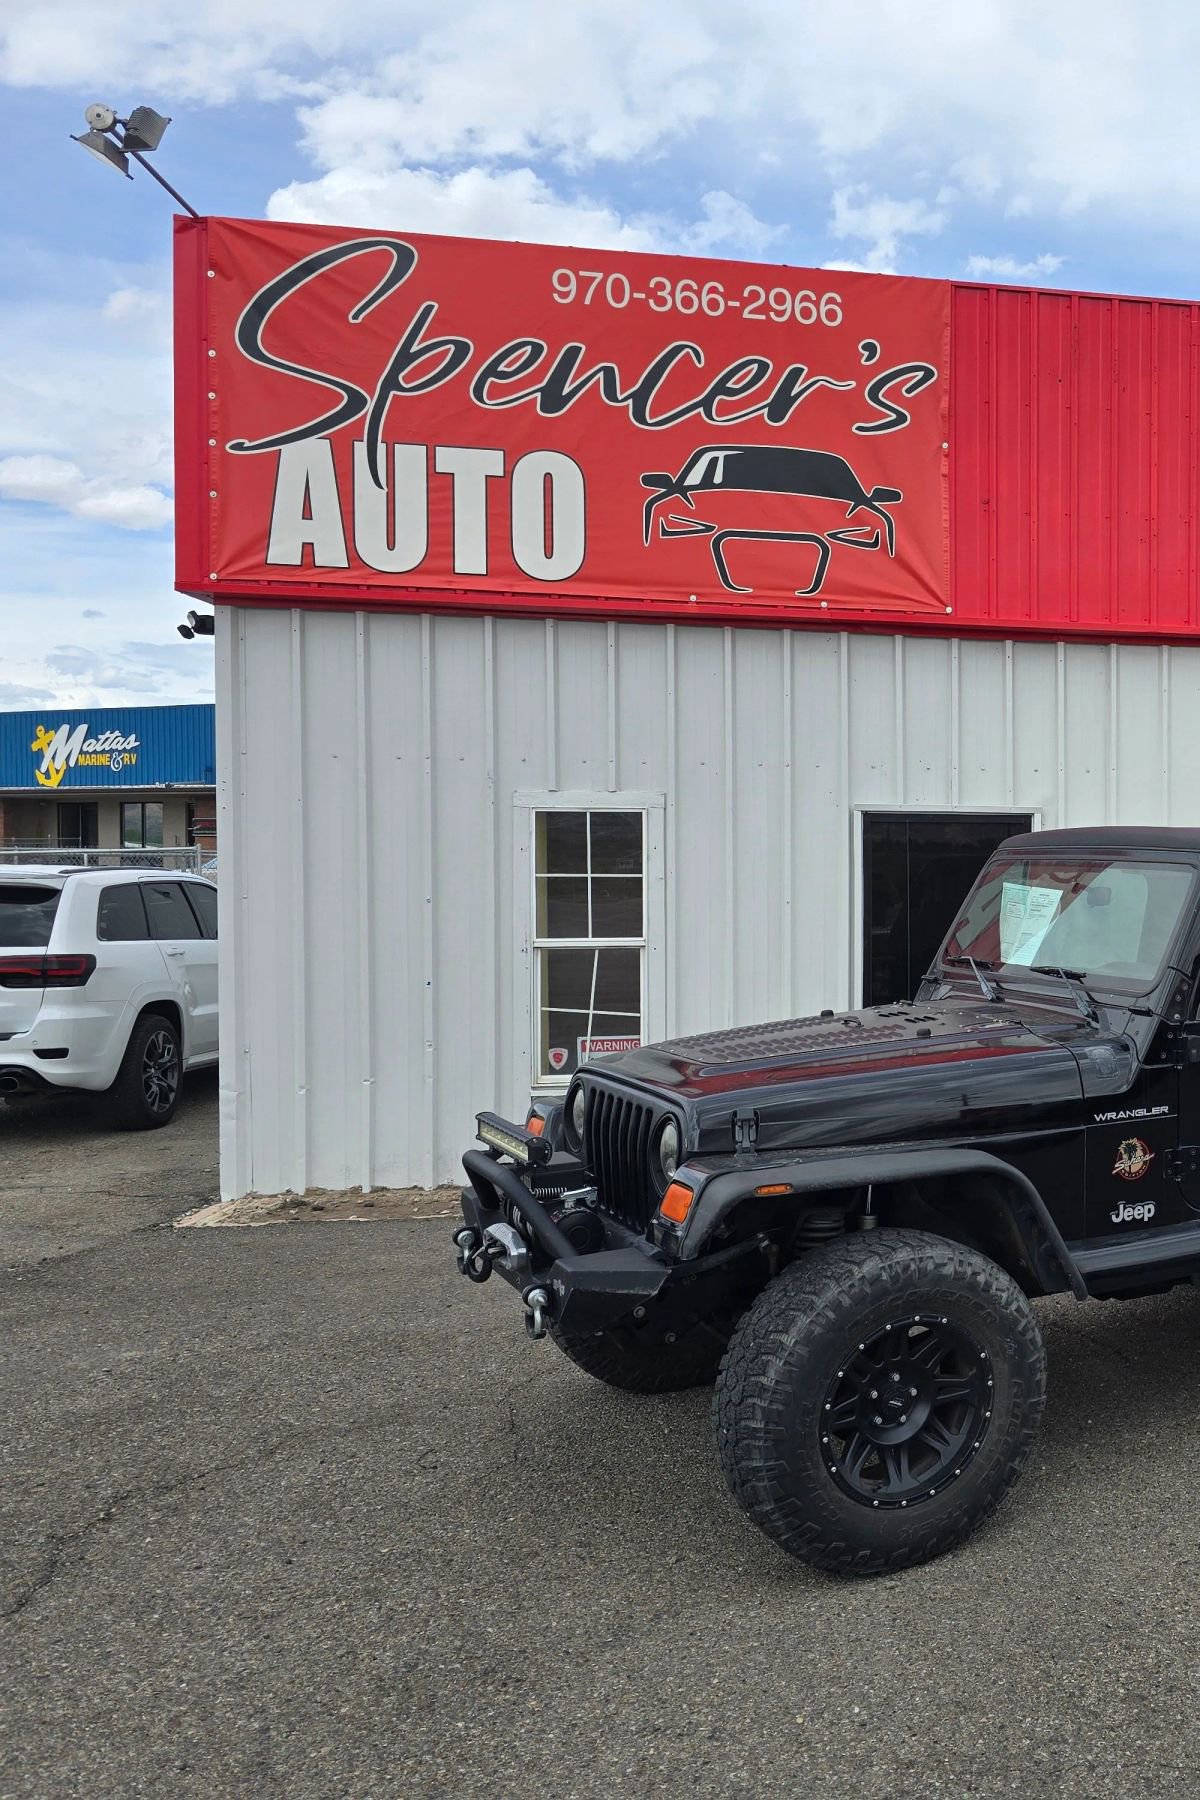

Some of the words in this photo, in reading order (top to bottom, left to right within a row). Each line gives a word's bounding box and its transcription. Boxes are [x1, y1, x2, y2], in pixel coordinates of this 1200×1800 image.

[552, 267, 843, 327] 970-366-2966
[228, 237, 938, 492] Spencer's
[265, 437, 587, 582] AUTO
[40, 724, 141, 773] Mattas
[78, 753, 110, 766] MARINE
[110, 752, 124, 772] &
[1094, 1106, 1169, 1121] WRANGLER
[1110, 1200, 1157, 1223] Jeep
